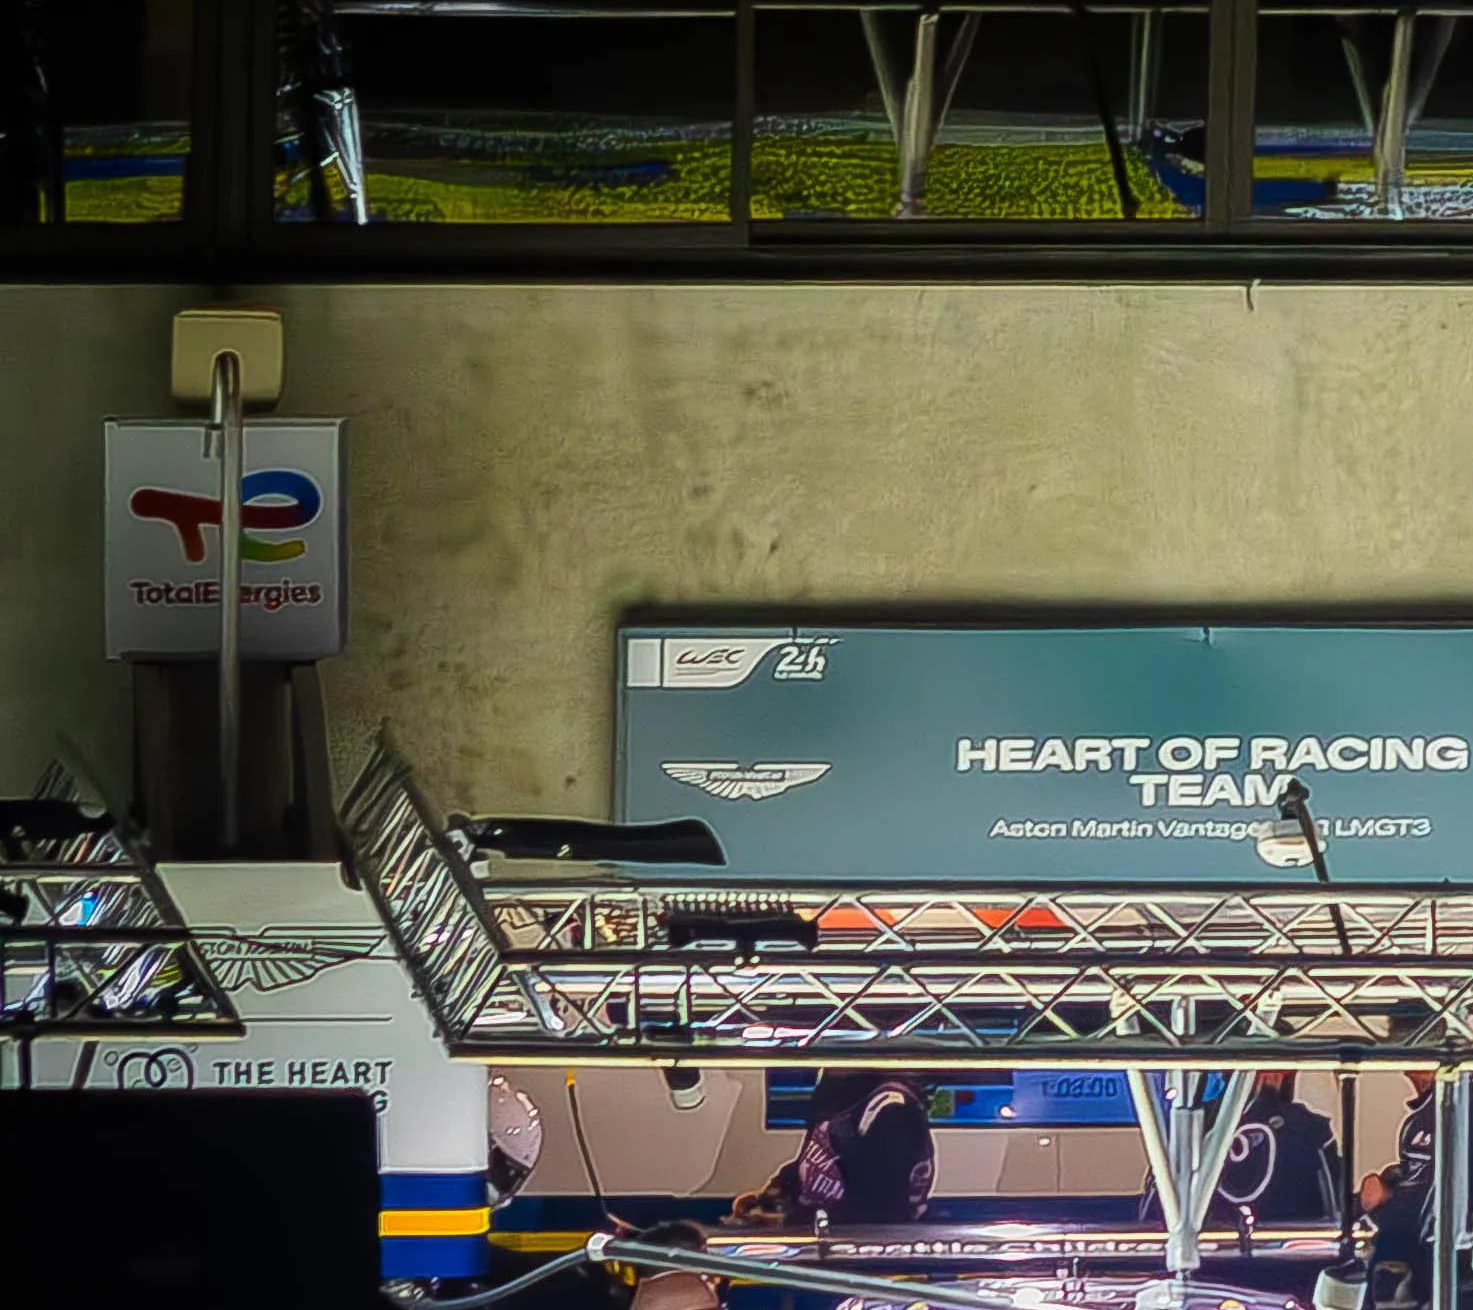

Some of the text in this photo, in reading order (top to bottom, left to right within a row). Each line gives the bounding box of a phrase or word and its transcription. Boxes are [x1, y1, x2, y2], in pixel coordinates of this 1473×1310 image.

[131, 580, 322, 610] TotalEergies
[958, 737, 1467, 770] HEART OF RACING
[1130, 774, 1290, 806] TEAM
[991, 819, 1066, 838] Aston
[1072, 819, 1153, 838] Martin
[1335, 818, 1431, 838] LMGT3
[213, 1061, 393, 1085] THE HEART
